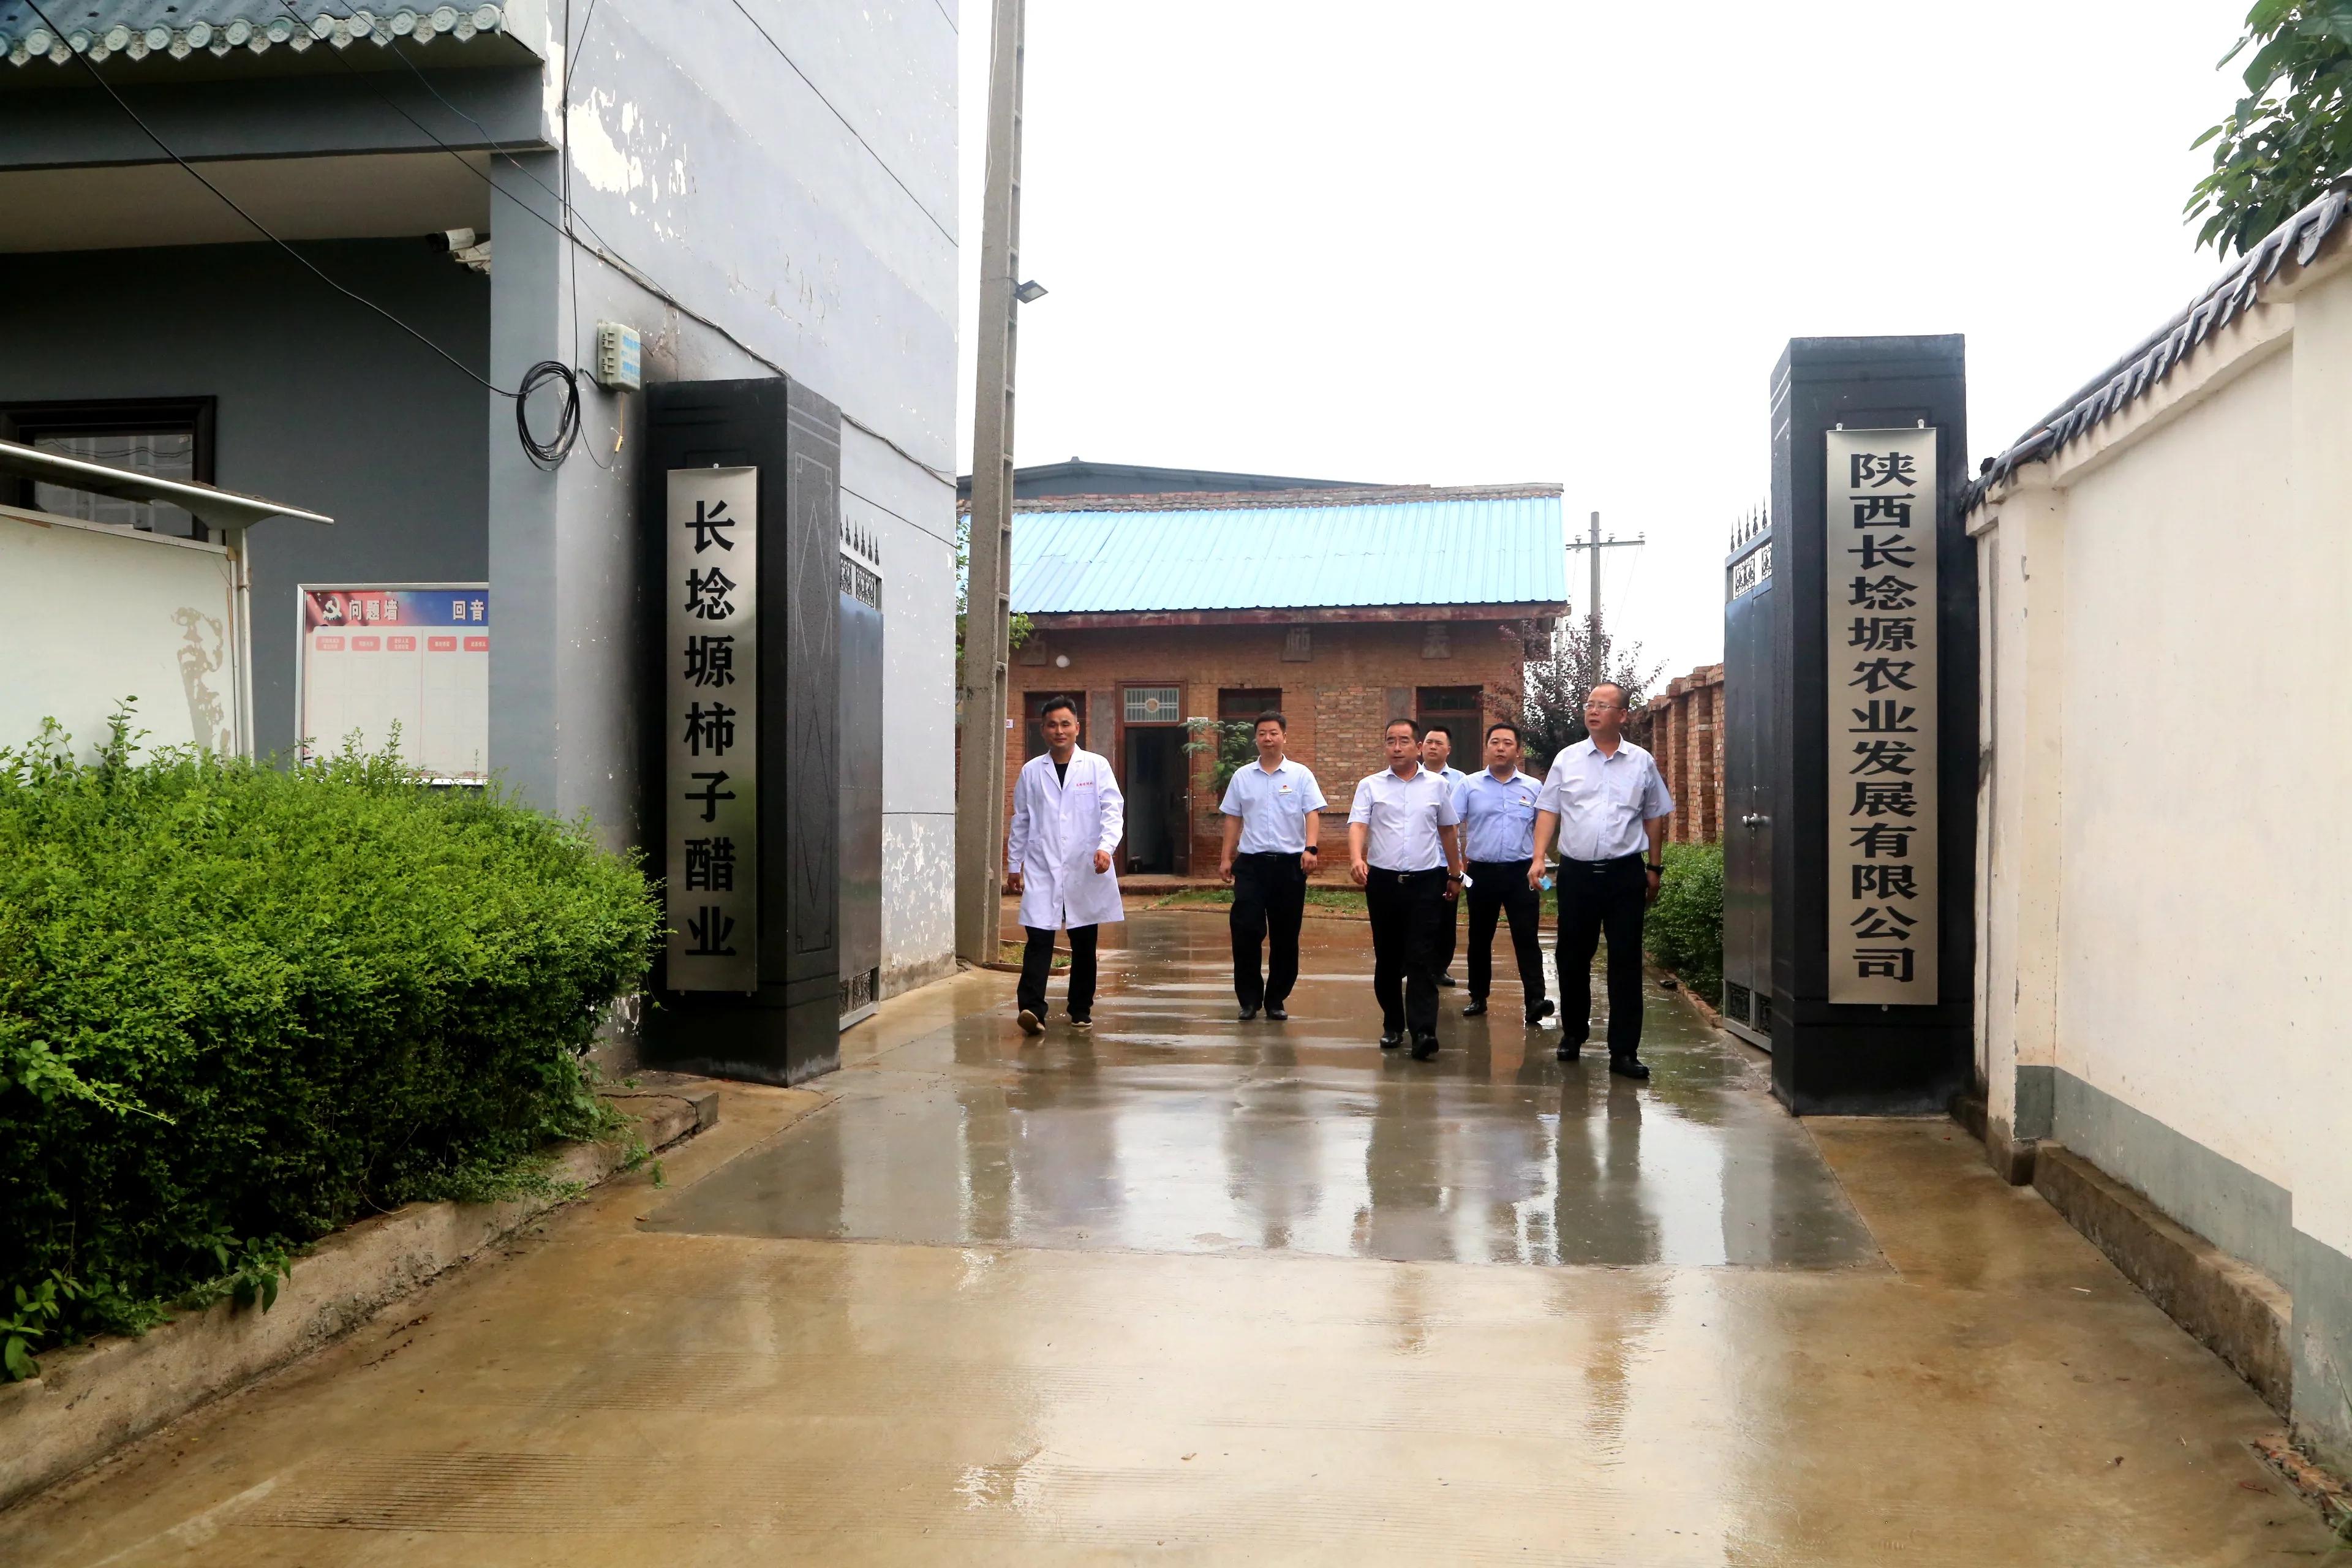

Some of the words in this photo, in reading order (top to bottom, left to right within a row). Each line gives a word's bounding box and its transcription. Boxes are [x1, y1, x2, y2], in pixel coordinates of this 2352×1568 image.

[349, 599, 398, 621] 问题墙
[684, 499, 737, 956] 长埝塬柿子醋业
[1847, 452, 1919, 984] 陕西长埝塬农业发展有限公司
